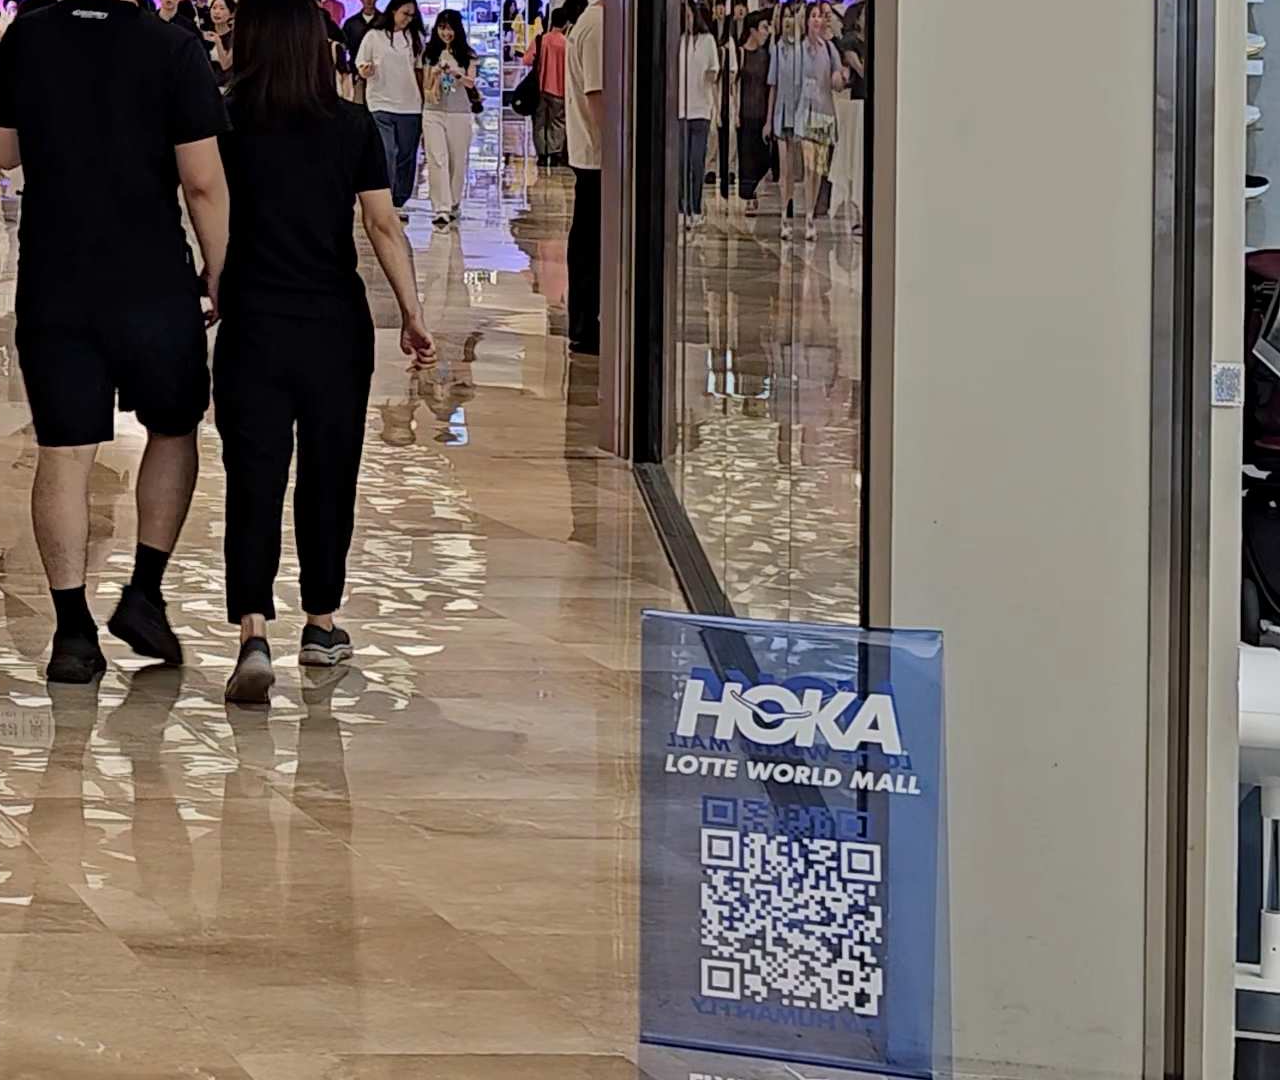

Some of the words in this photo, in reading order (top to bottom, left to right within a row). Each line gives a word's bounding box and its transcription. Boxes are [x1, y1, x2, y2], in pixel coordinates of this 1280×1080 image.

[676, 679, 904, 755] HOKA
[665, 754, 739, 778] LOTTE
[745, 761, 842, 788] WORLD
[849, 771, 921, 795] MALL
